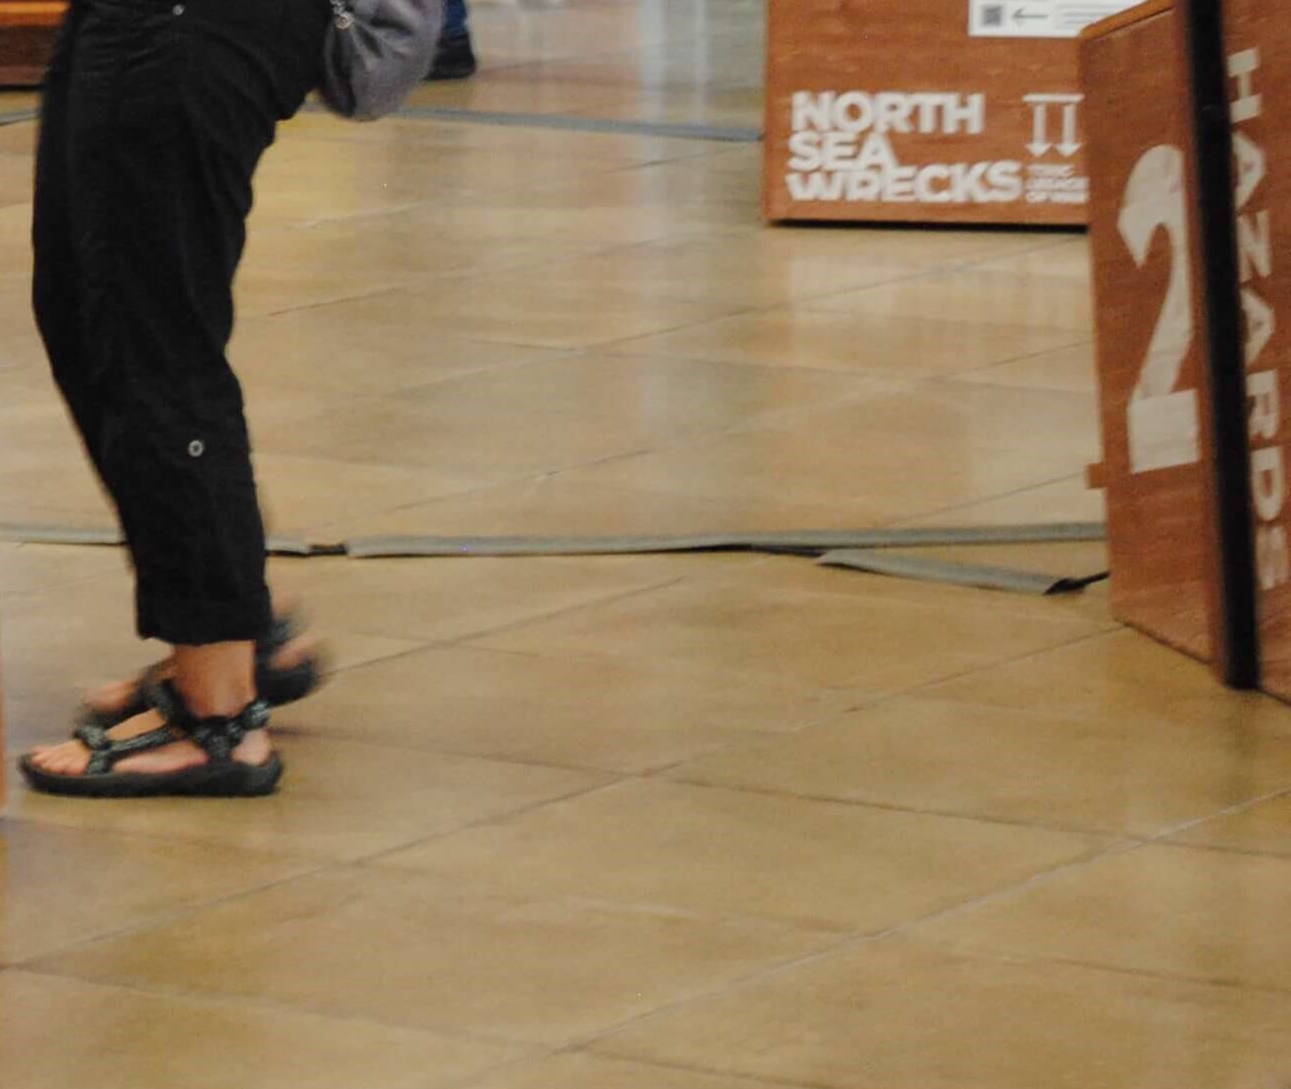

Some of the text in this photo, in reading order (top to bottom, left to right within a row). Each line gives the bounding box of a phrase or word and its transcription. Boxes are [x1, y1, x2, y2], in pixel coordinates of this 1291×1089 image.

[791, 90, 986, 134] NORTH
[788, 130, 899, 171] SEA
[785, 160, 1021, 202] WRECKS
[1116, 143, 1199, 475] 2
[1225, 47, 1290, 591] HAZARDS
